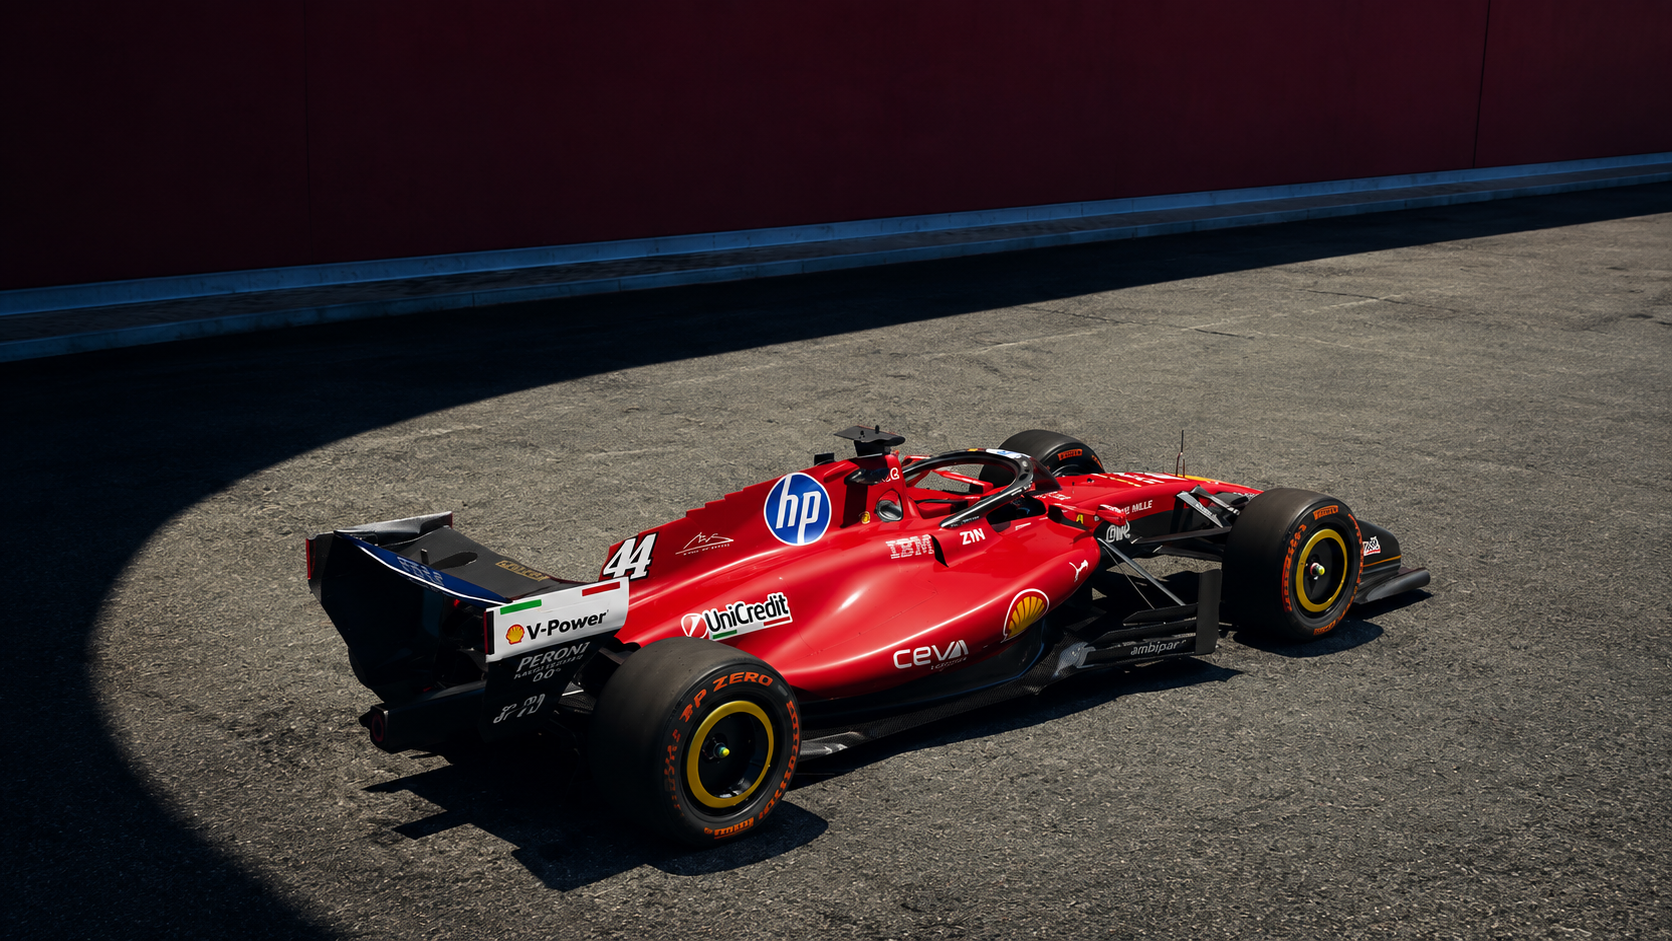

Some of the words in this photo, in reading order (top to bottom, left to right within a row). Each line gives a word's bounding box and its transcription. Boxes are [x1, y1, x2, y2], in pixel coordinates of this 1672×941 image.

[776, 474, 821, 546] hp
[603, 532, 657, 580] 44
[526, 611, 608, 640] V-Power
[704, 594, 789, 633] UniCredit
[516, 641, 591, 672] PERONI
[1130, 641, 1180, 655] ambipar
[712, 671, 774, 693] ZERO
